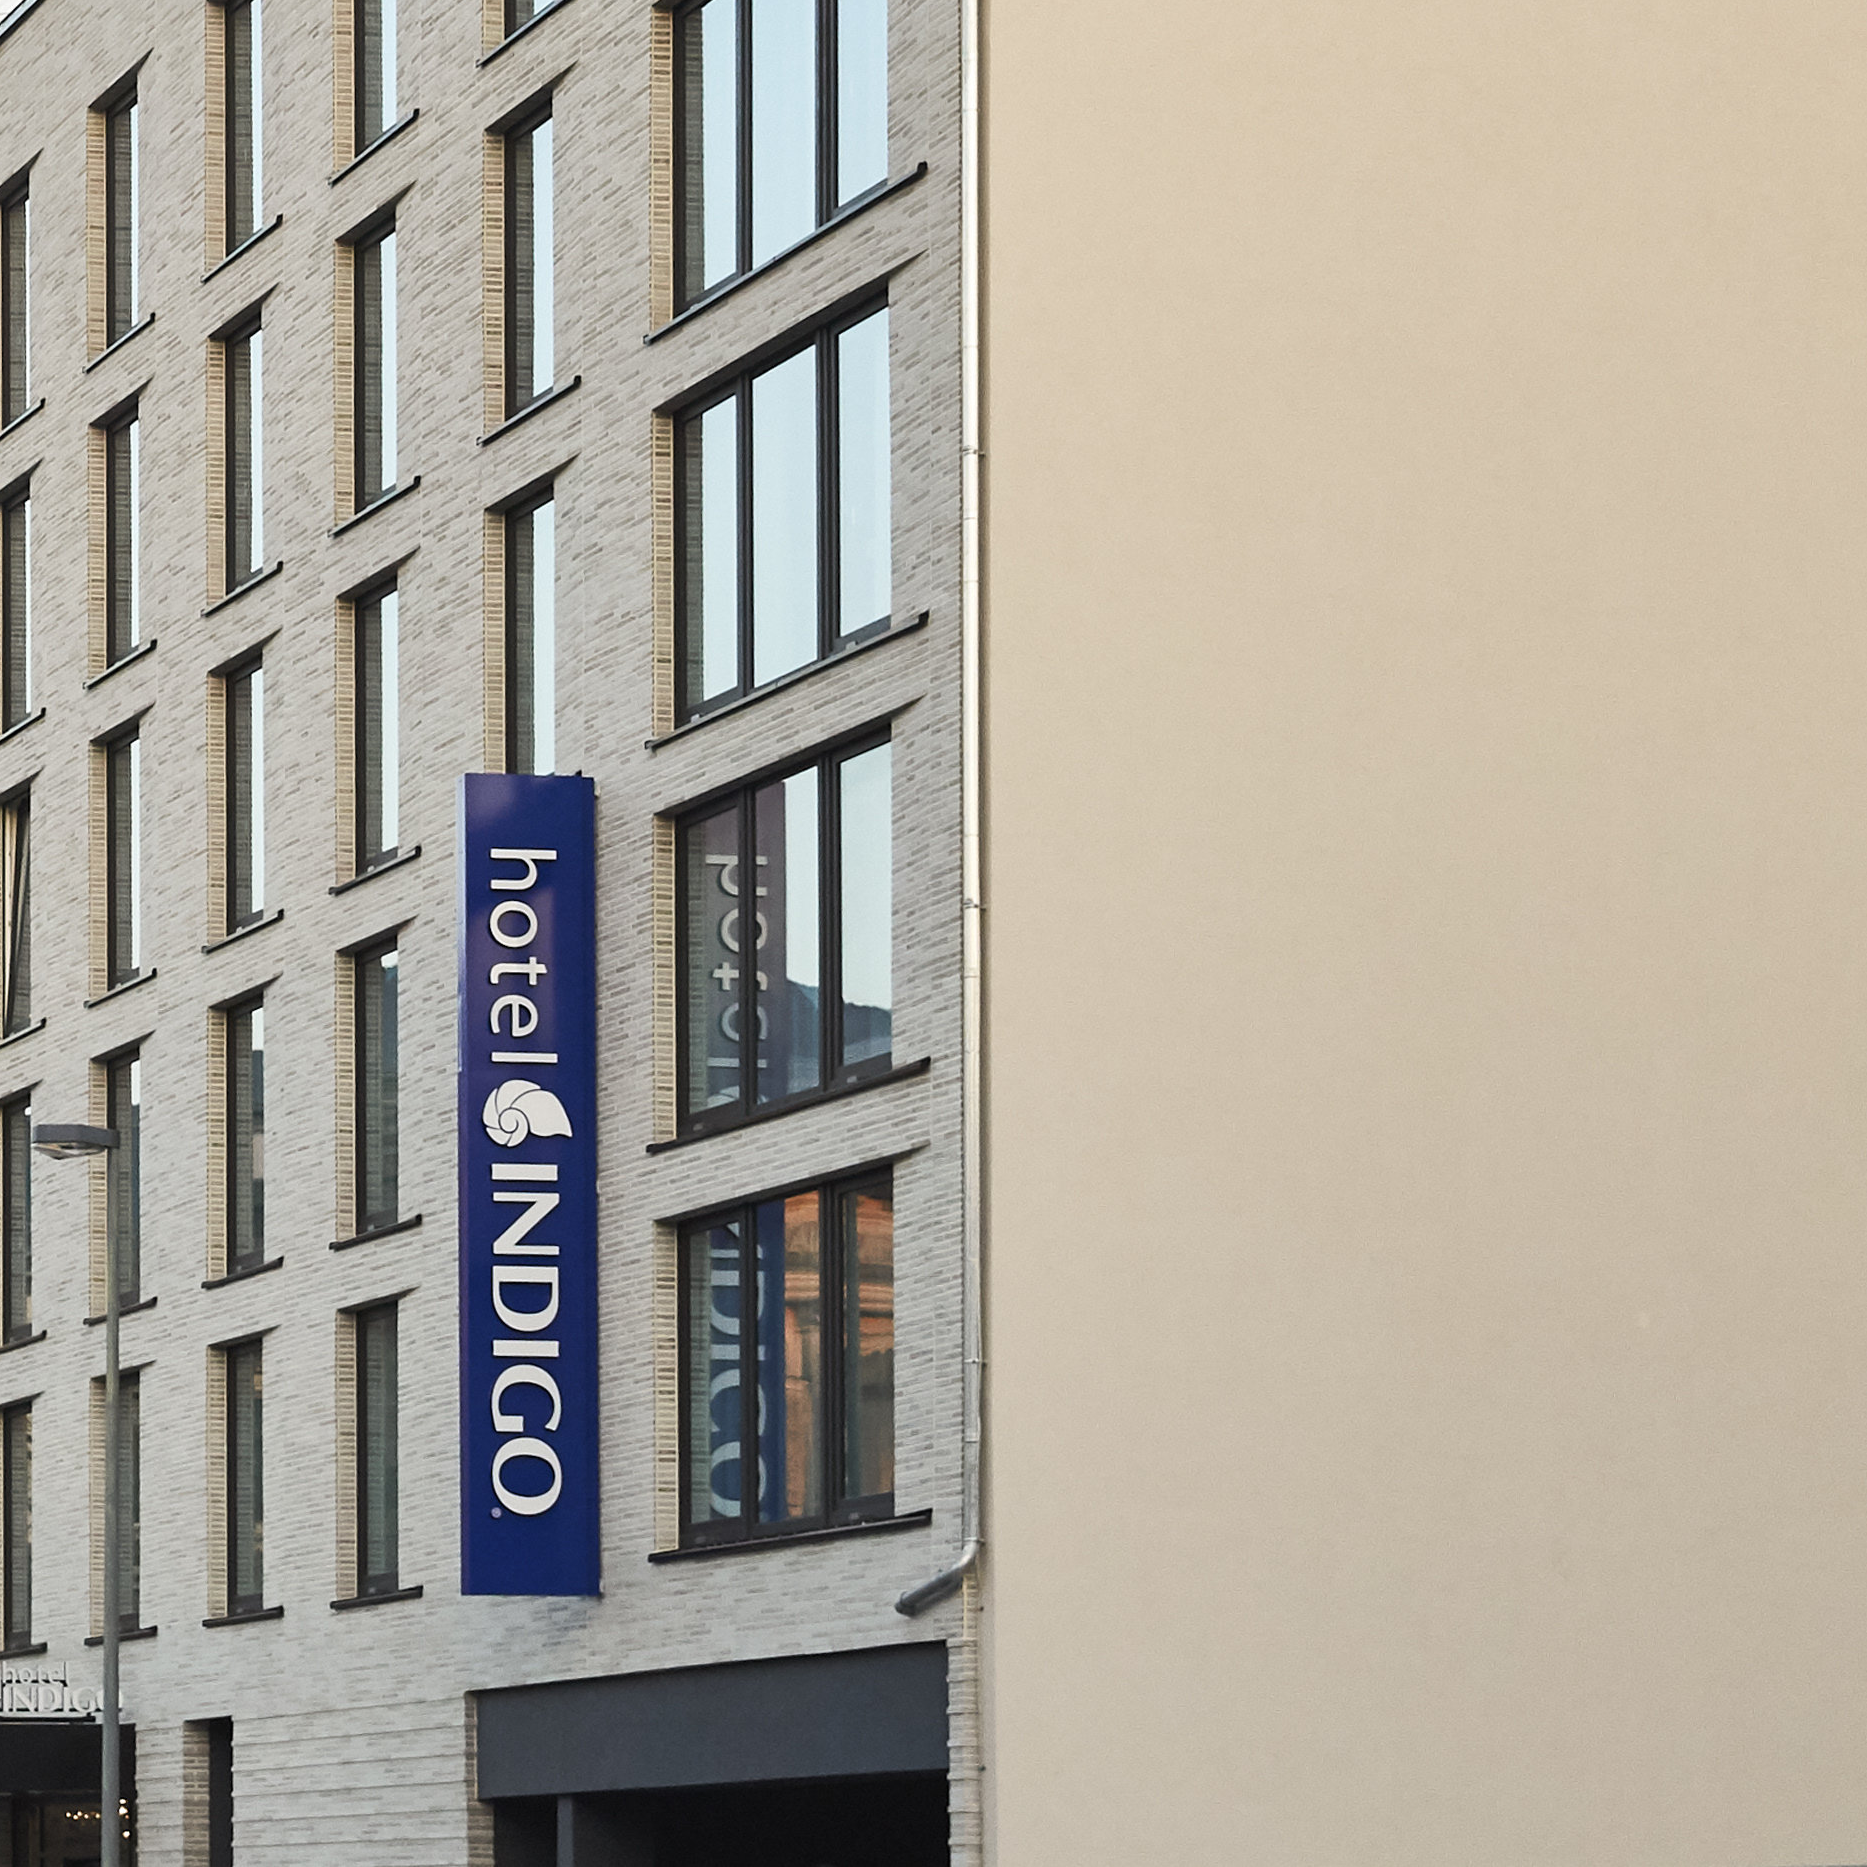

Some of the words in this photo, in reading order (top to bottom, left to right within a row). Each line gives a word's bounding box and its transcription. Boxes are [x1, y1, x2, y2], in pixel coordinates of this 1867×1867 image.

[489, 847, 559, 1064] hotel
[490, 1162, 563, 1517] INDIGO
[2, 1661, 70, 1684] hotel
